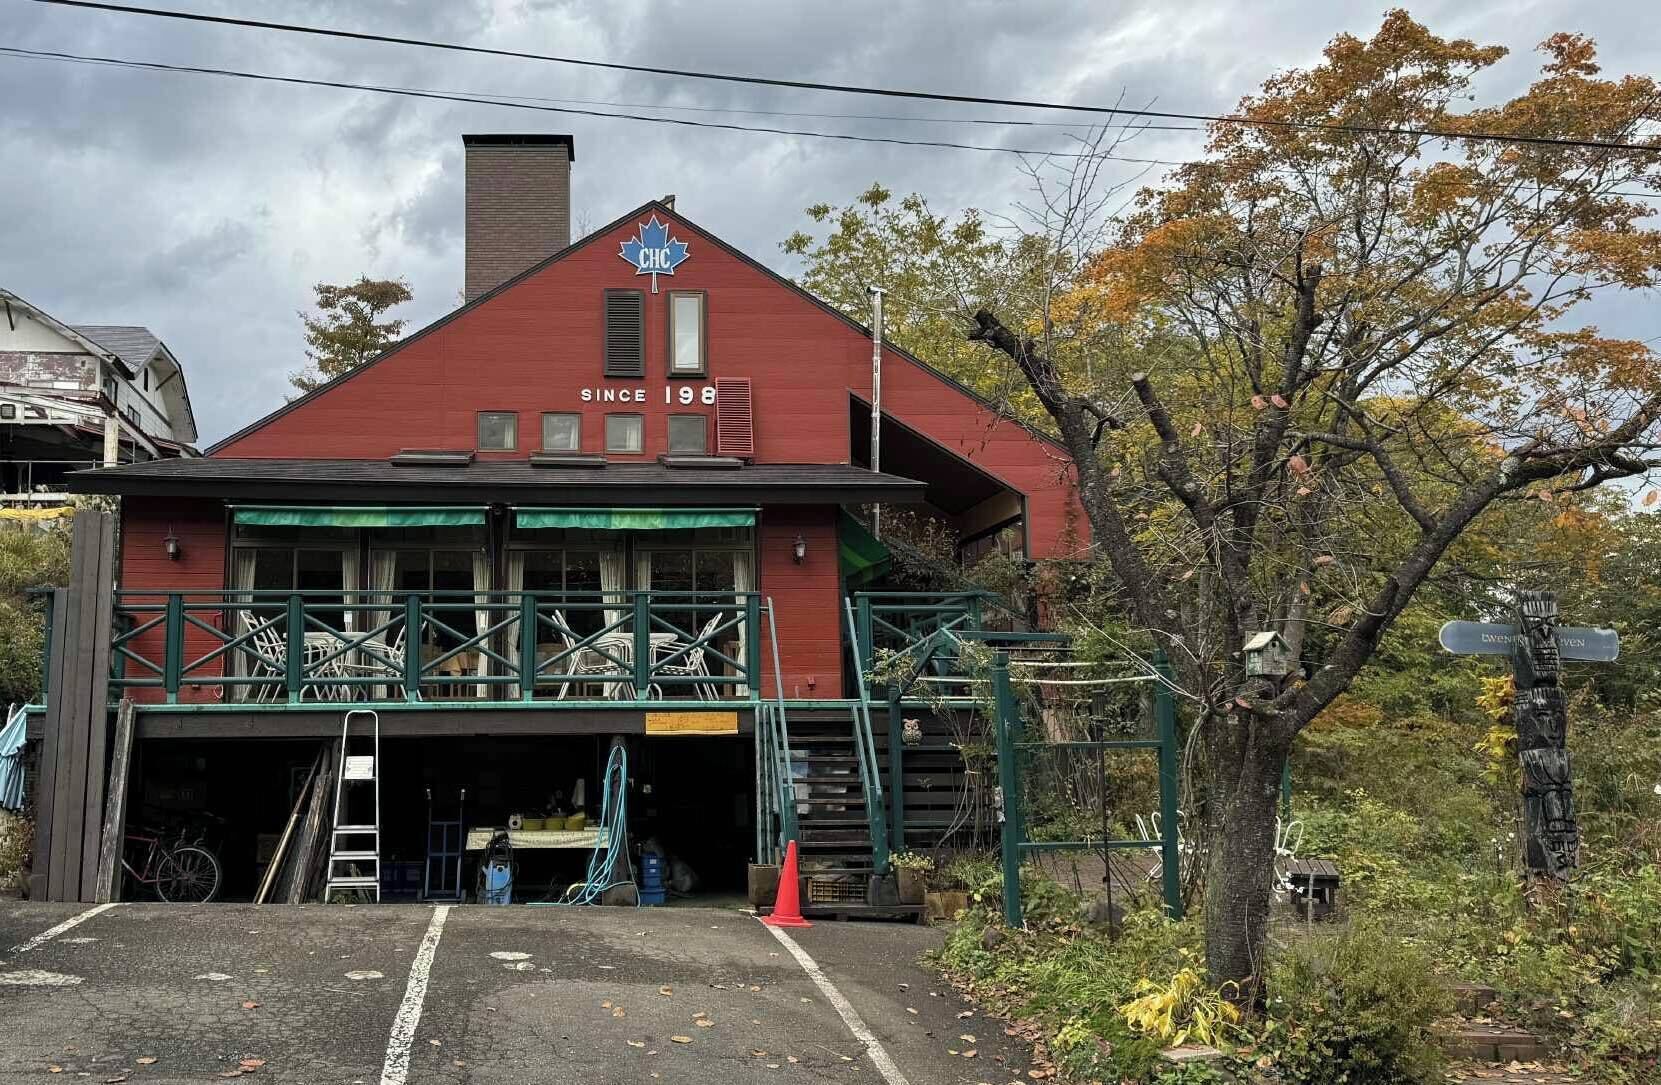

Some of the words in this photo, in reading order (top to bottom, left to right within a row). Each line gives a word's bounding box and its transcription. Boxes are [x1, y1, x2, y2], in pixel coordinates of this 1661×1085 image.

[638, 247, 671, 269] CHC
[580, 388, 647, 402] SINCE
[665, 385, 716, 405] 198
